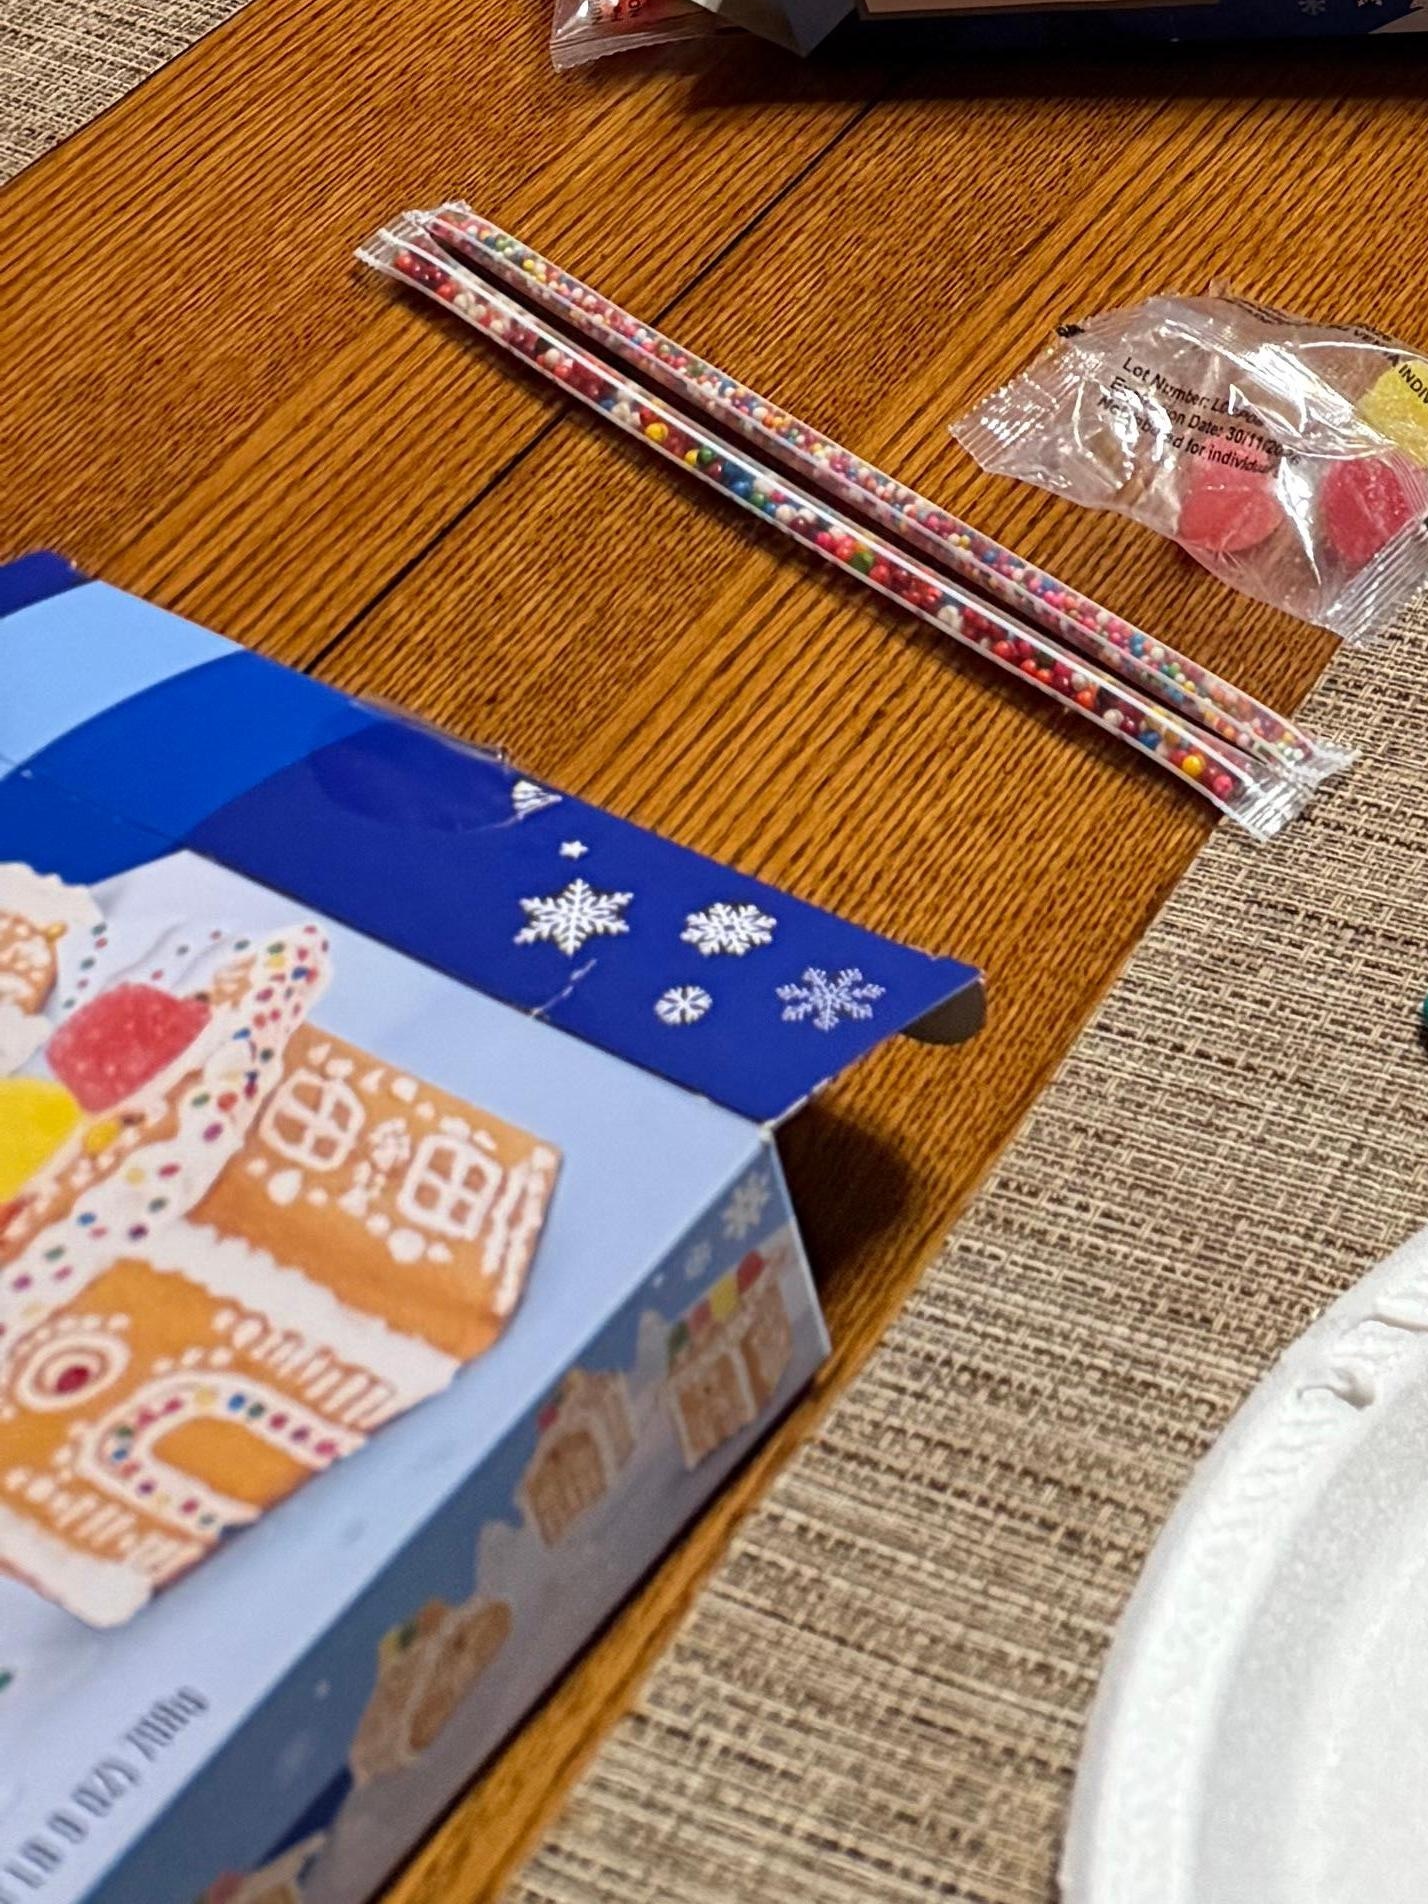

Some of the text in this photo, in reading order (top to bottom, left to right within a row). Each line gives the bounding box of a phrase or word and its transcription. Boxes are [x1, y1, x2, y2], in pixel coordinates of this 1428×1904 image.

[1122, 356, 1151, 384] Lot
[1152, 372, 1211, 411] Number:
[1186, 414, 1223, 438] Date:
[1185, 439, 1205, 457] for
